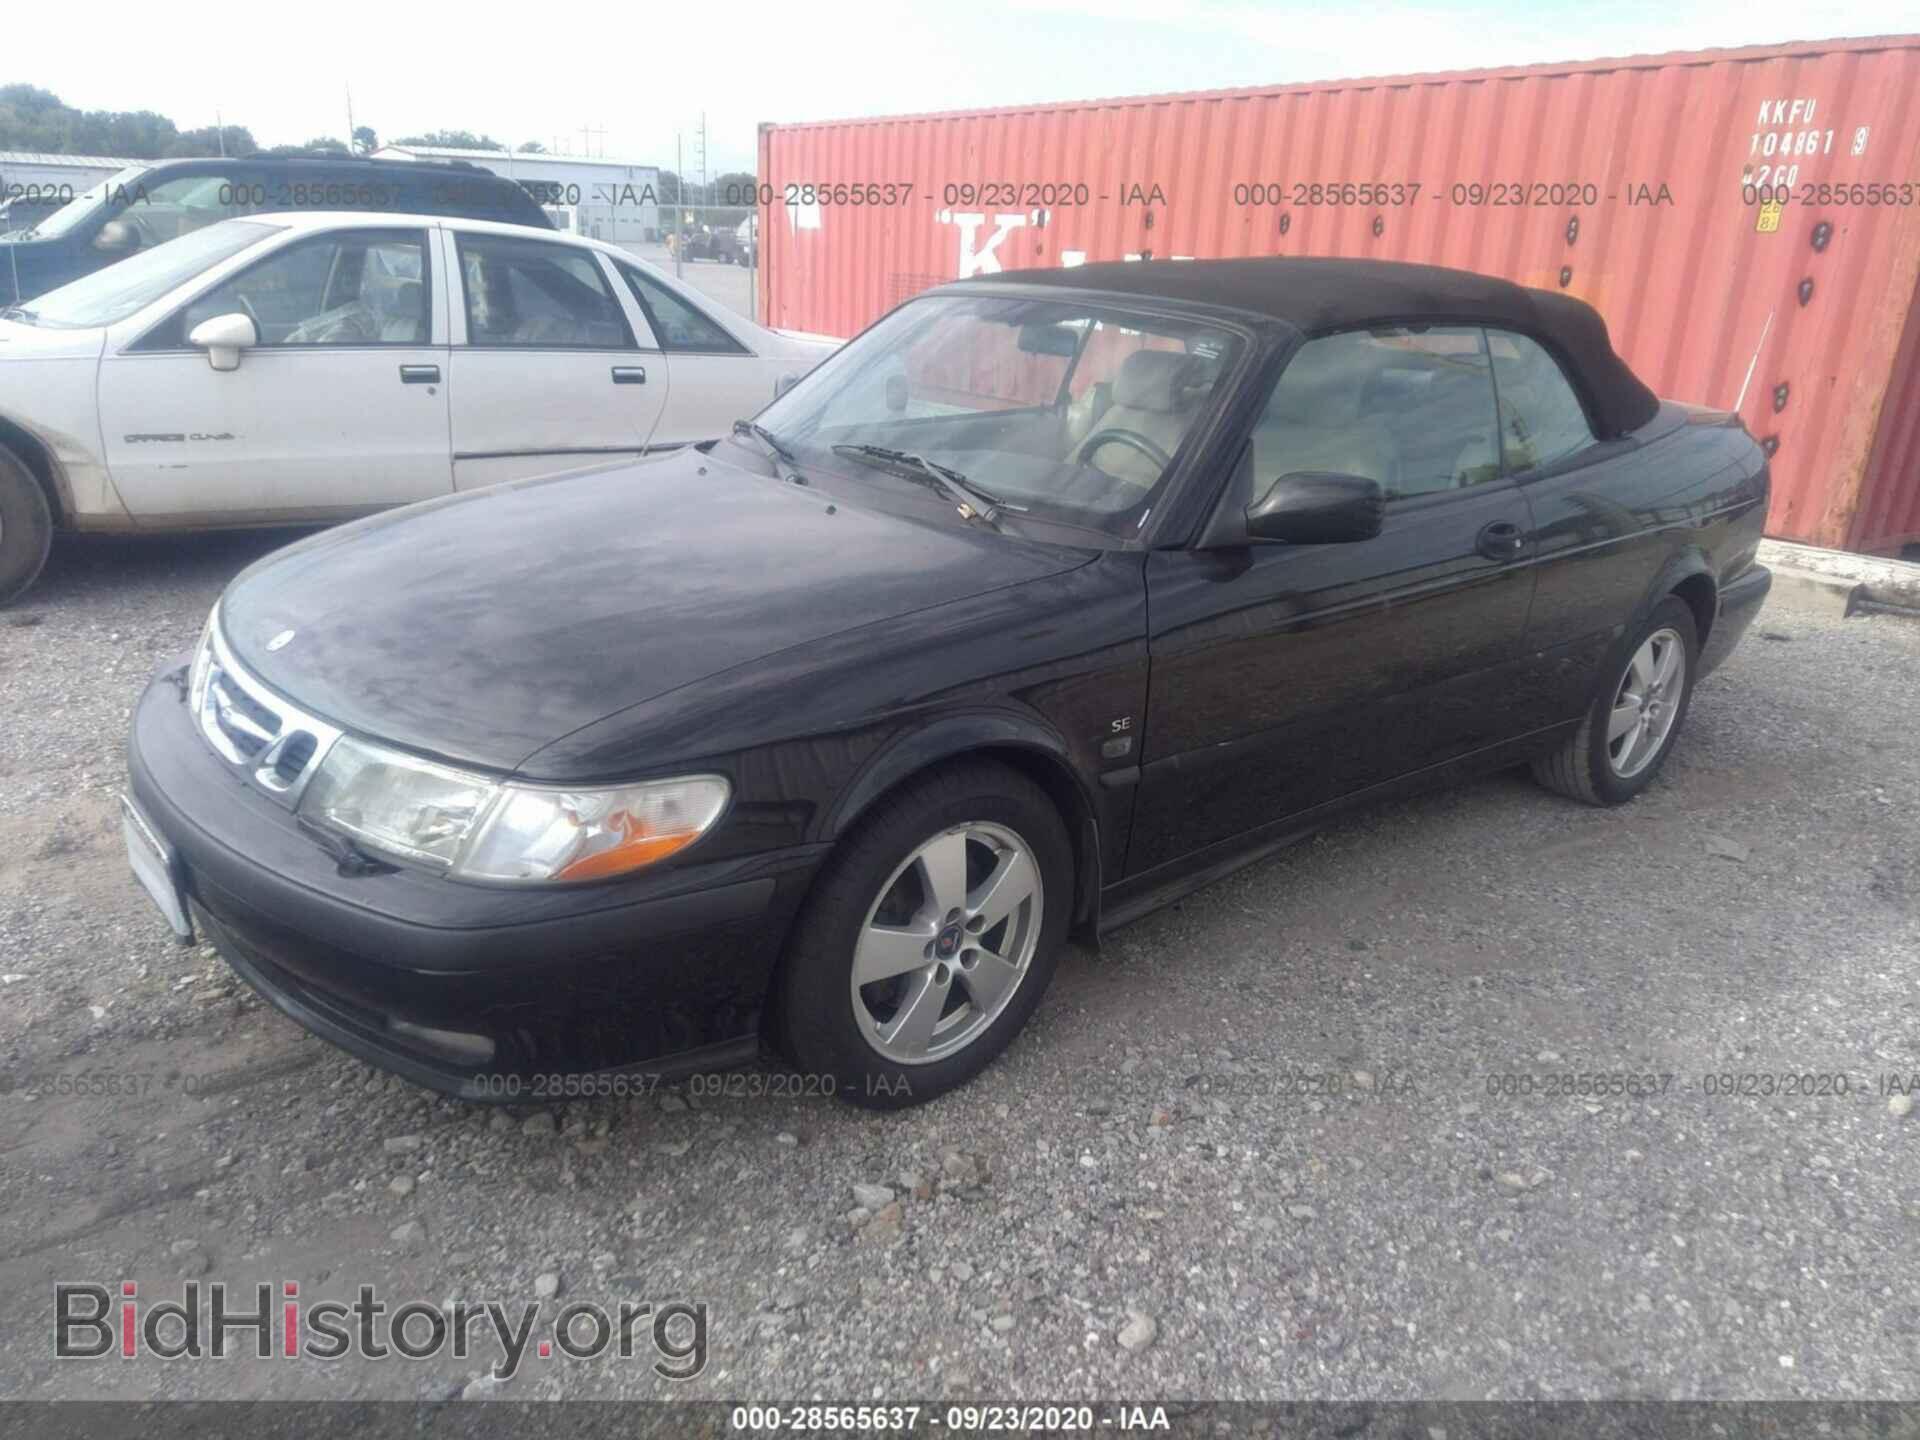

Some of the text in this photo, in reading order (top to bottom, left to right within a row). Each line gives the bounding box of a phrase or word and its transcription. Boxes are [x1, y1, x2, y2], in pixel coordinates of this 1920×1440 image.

[1758, 99, 1816, 125] KKFU
[1750, 125, 1870, 157] 104861 9
[1111, 716, 1131, 733] SE
